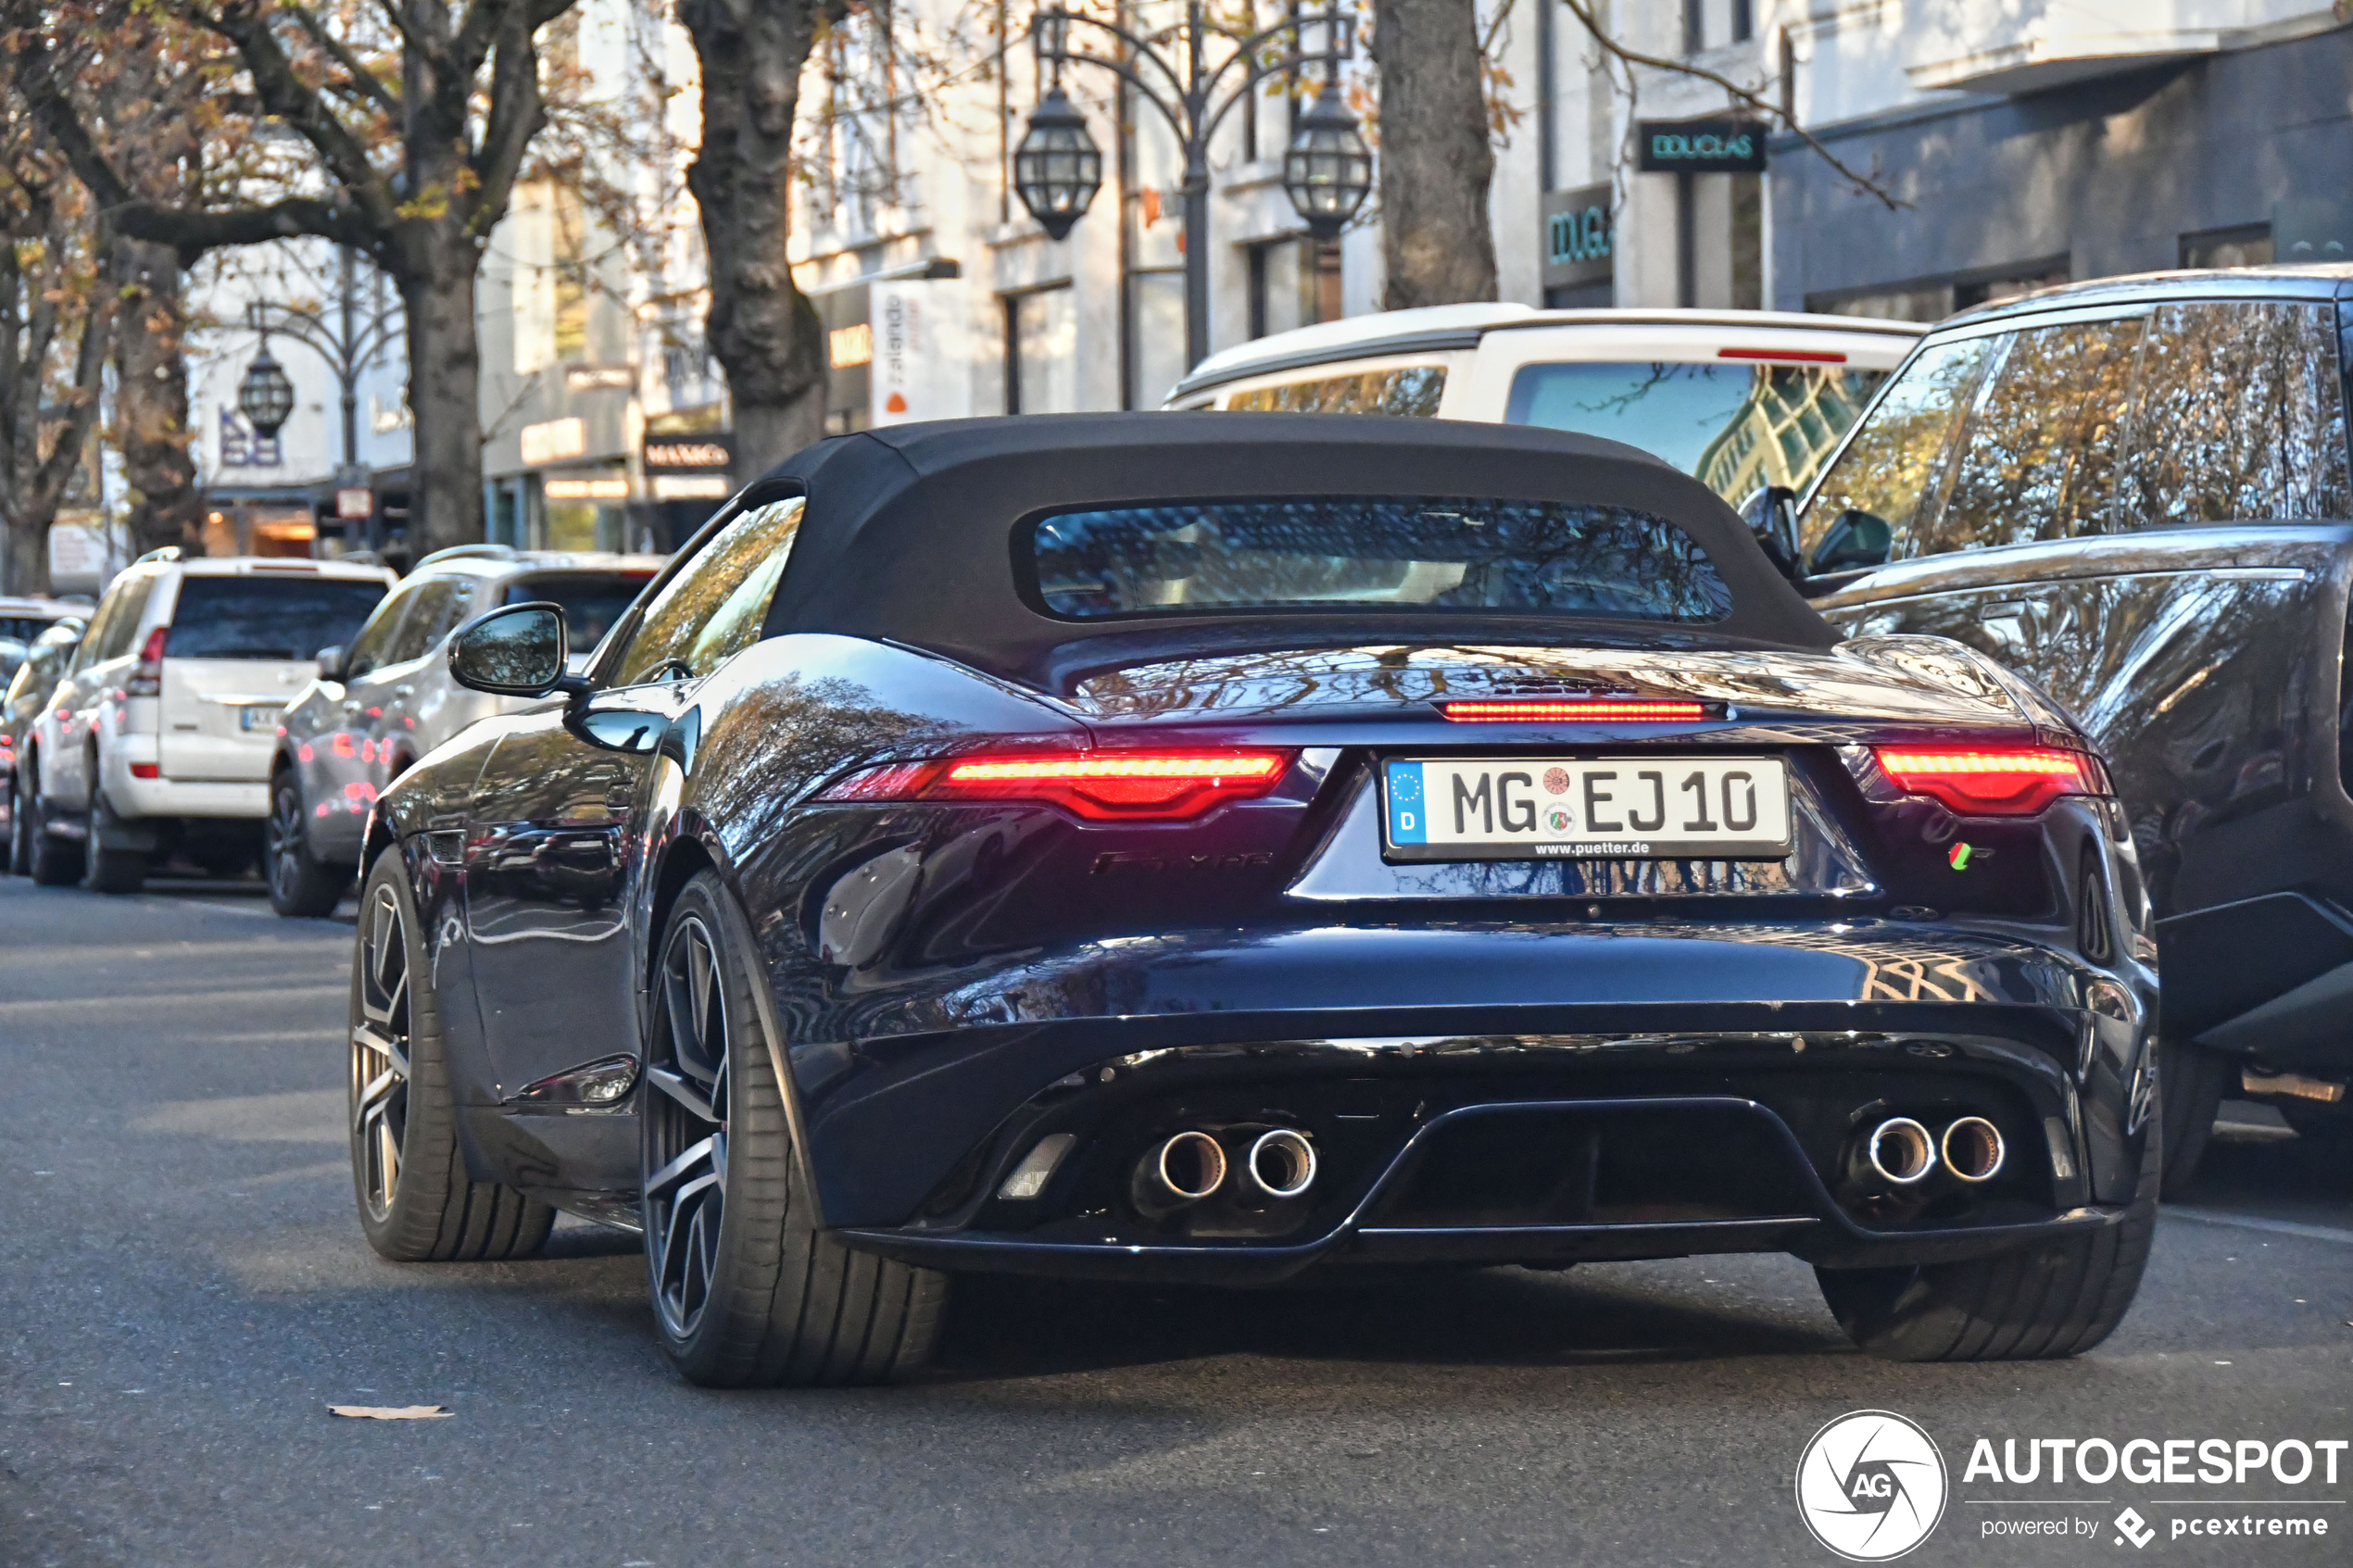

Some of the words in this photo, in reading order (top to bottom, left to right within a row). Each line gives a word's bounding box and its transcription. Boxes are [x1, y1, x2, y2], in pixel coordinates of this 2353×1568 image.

[1452, 771, 1537, 834] MG
[1400, 811, 1416, 831] D
[1534, 842, 1650, 856] www.puetter.de
